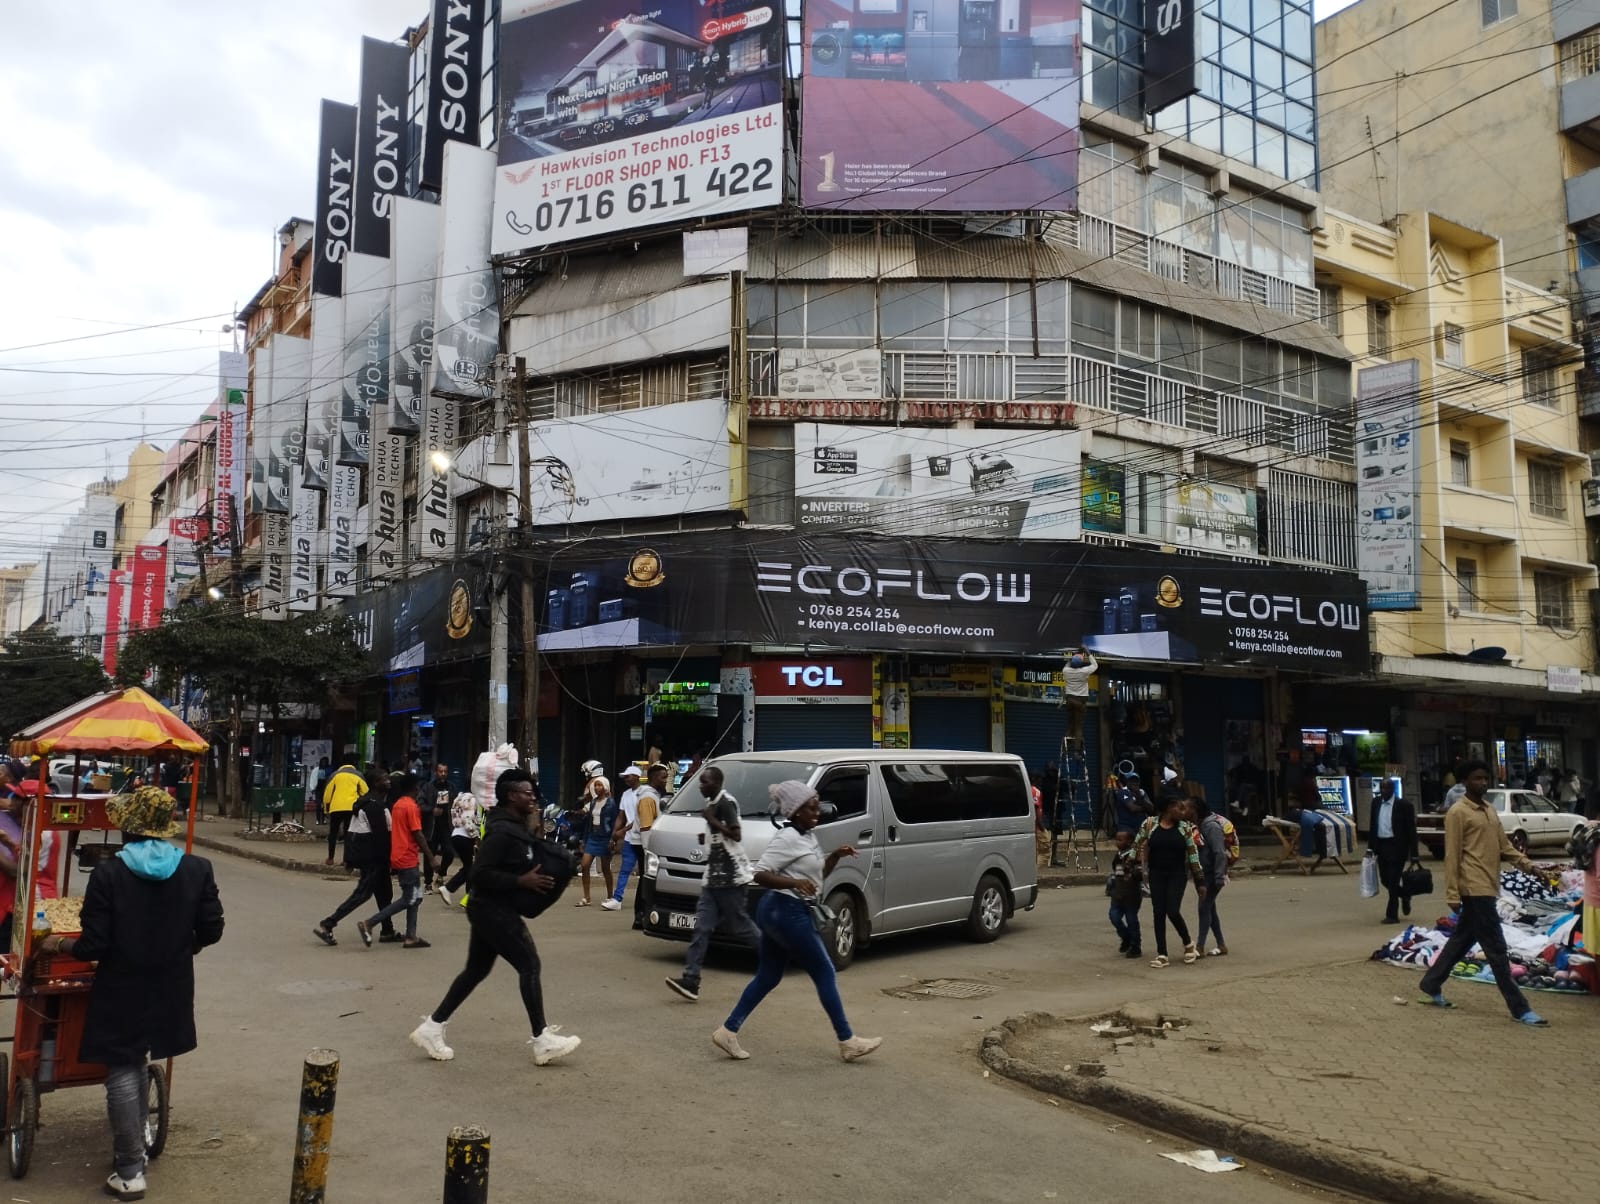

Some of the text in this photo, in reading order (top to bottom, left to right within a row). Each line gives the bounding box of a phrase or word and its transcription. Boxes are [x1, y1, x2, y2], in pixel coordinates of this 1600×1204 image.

[721, 17, 748, 31] Hybrid
[748, 11, 769, 23] Light
[440, 0, 471, 134] SONY
[557, 69, 669, 105] Next-level Night Vision
[557, 105, 578, 119] with
[372, 94, 400, 219] SONY
[541, 112, 778, 177] Hawkvision Technologies Ltd.
[565, 168, 615, 194] FLOOR
[619, 158, 662, 182] SHOP
[666, 153, 694, 173] NO.
[699, 143, 732, 166] F13
[324, 148, 352, 264] SONY
[535, 157, 774, 232] 0716 611 422
[460, 362, 475, 374] 13
[377, 440, 387, 481] DAHUA
[826, 452, 839, 460] App
[334, 470, 343, 508] DAHUA
[809, 501, 1010, 517] INVERTERS SOLAR
[957, 518, 982, 528] SHOP
[143, 572, 156, 599] Enjoy
[757, 561, 1031, 603] ECOFLOW
[809, 604, 900, 619] 0768 254 254
[1199, 586, 1360, 631] ECOFLOW
[808, 618, 995, 637] kenya.collab@ecoflow.com
[1235, 627, 1289, 641] 0768 254 254
[1235, 640, 1343, 659] kenya.collab@ecoflow.com
[781, 666, 843, 687] TCL
